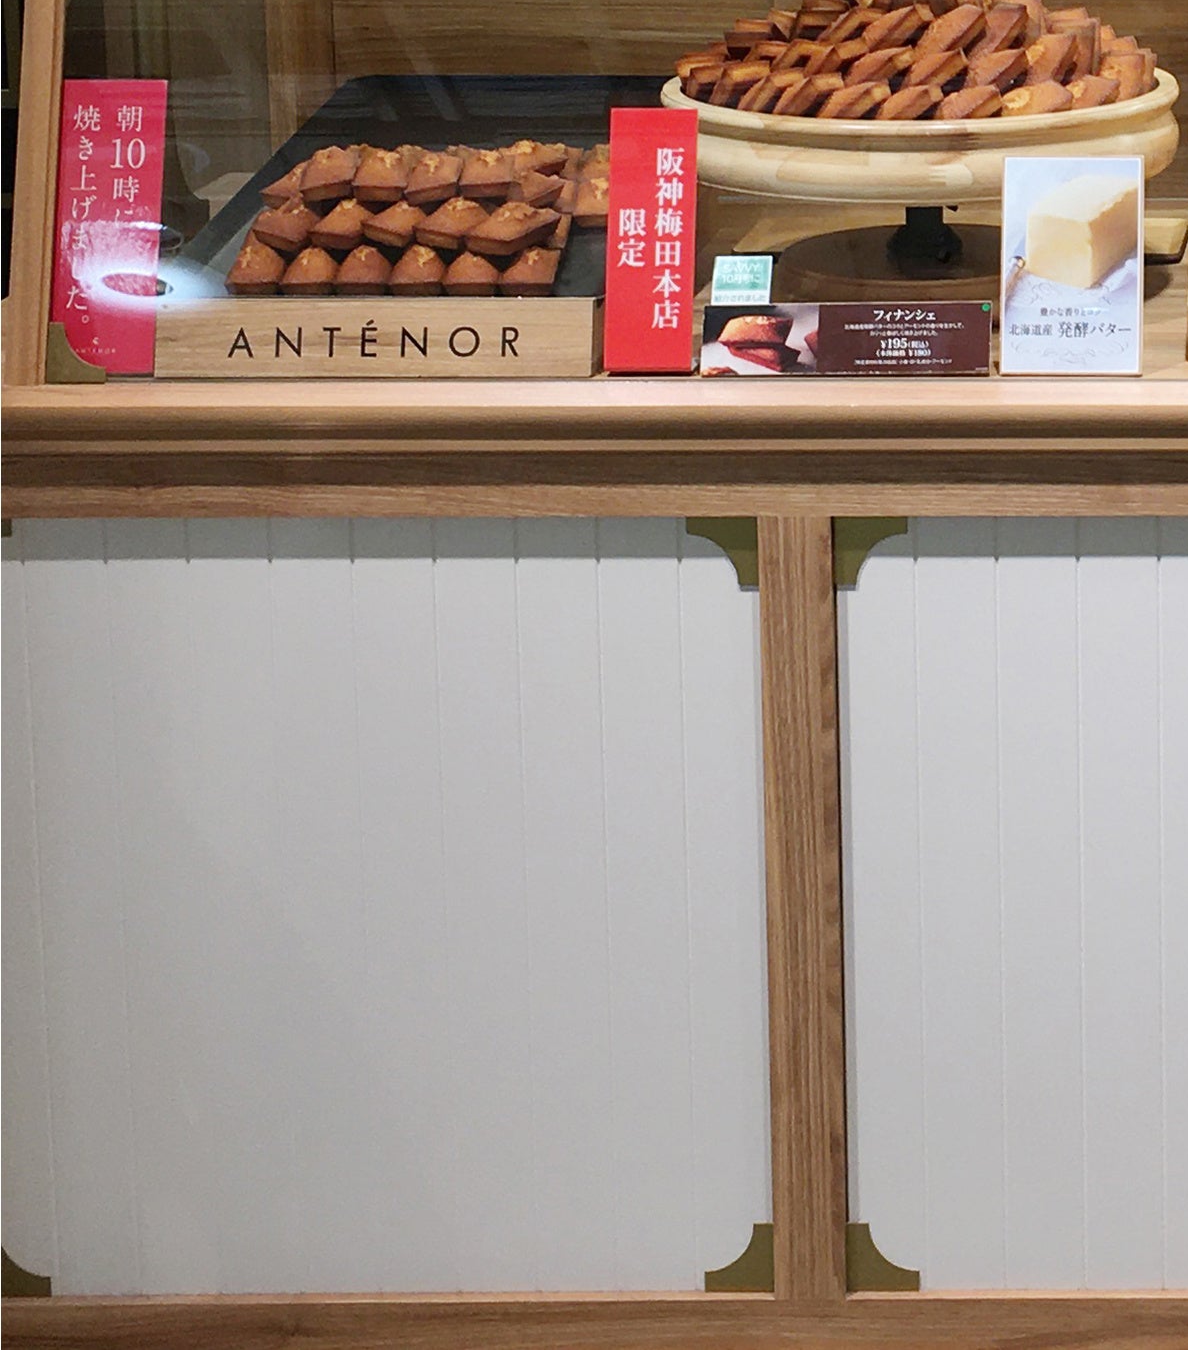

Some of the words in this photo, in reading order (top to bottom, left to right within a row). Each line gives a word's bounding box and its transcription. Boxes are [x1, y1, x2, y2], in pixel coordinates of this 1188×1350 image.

[617, 208, 647, 268] 限定
[651, 147, 685, 329] 阪神梅田本店
[873, 309, 937, 321] フィナンシェ
[1009, 323, 1053, 336] 北海道産
[1058, 321, 1131, 338] 発酵バター
[227, 319, 521, 359] ANTÉNOR
